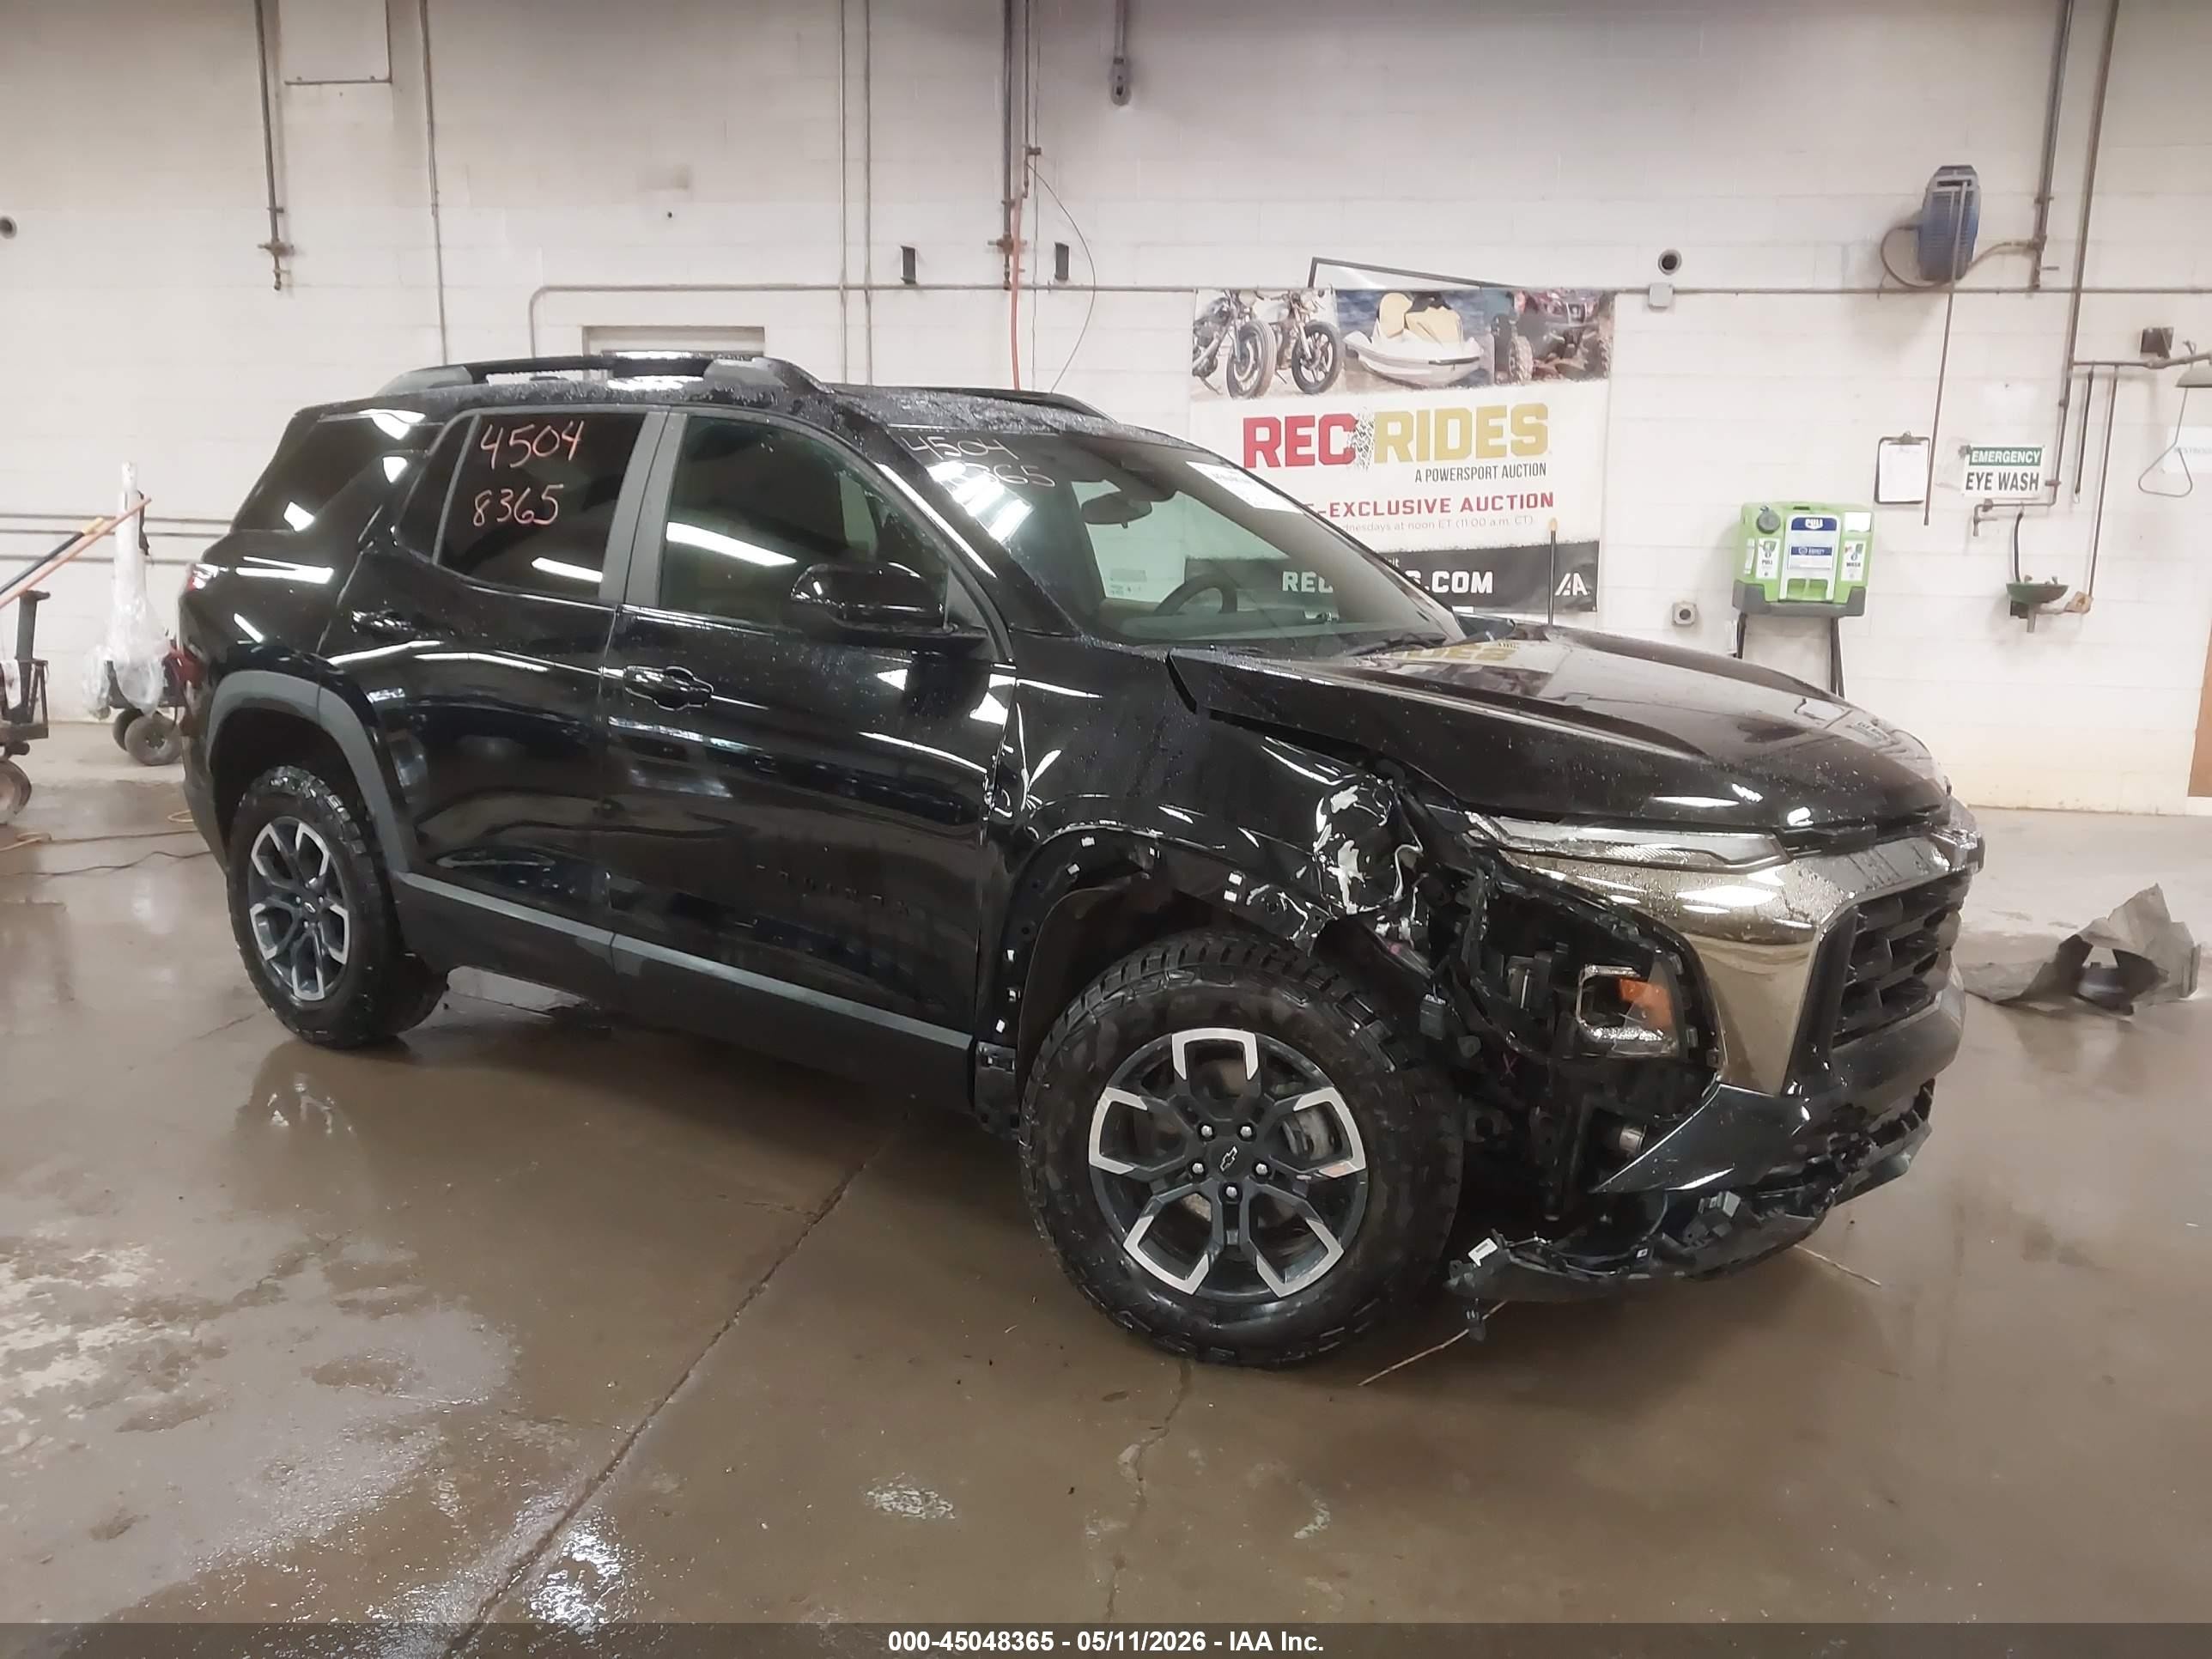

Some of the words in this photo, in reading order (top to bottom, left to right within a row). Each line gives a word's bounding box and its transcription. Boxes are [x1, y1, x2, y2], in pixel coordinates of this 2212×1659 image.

[480, 420, 585, 471] 4504
[1243, 413, 1359, 468] REC
[1374, 402, 1549, 465] RIDES
[901, 434, 1020, 461] 4504
[1971, 450, 2041, 464] EMERGENCY
[1414, 469, 1422, 483] A
[1425, 465, 1498, 483] POWERSPORT
[1502, 462, 1547, 479] AUCTION
[1966, 471, 1993, 490] EYE
[1998, 471, 2039, 491] WASH
[473, 483, 564, 527] 8365
[1460, 491, 1553, 513] AUCTION
[1407, 520, 1435, 530] noon
